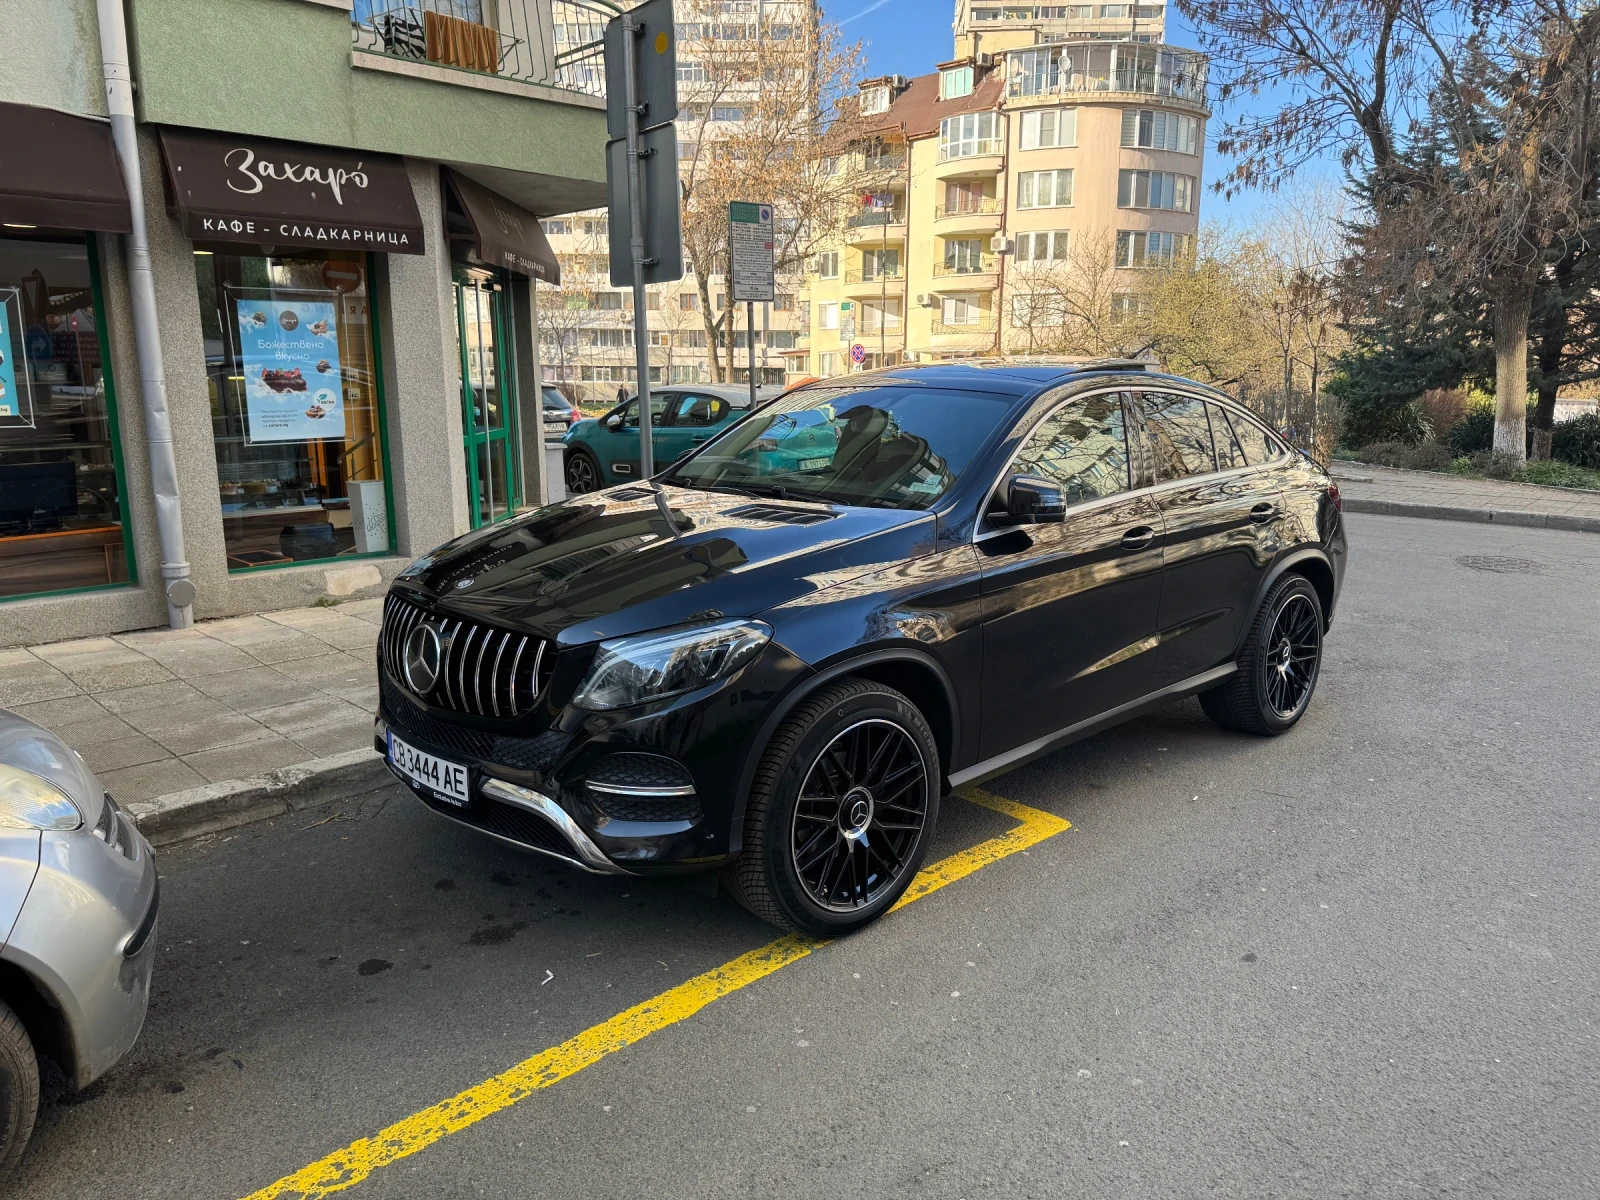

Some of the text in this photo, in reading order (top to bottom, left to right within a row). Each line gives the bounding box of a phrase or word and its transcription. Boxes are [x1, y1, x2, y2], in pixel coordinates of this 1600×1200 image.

[203, 218, 256, 233] КАФЕ
[280, 224, 409, 245] СЛАДКАРНИЦА
[257, 340, 325, 349] Божествено
[275, 351, 310, 362] вкусно
[393, 739, 406, 768] CB
[407, 748, 440, 787] 3444
[444, 764, 466, 796] AE
